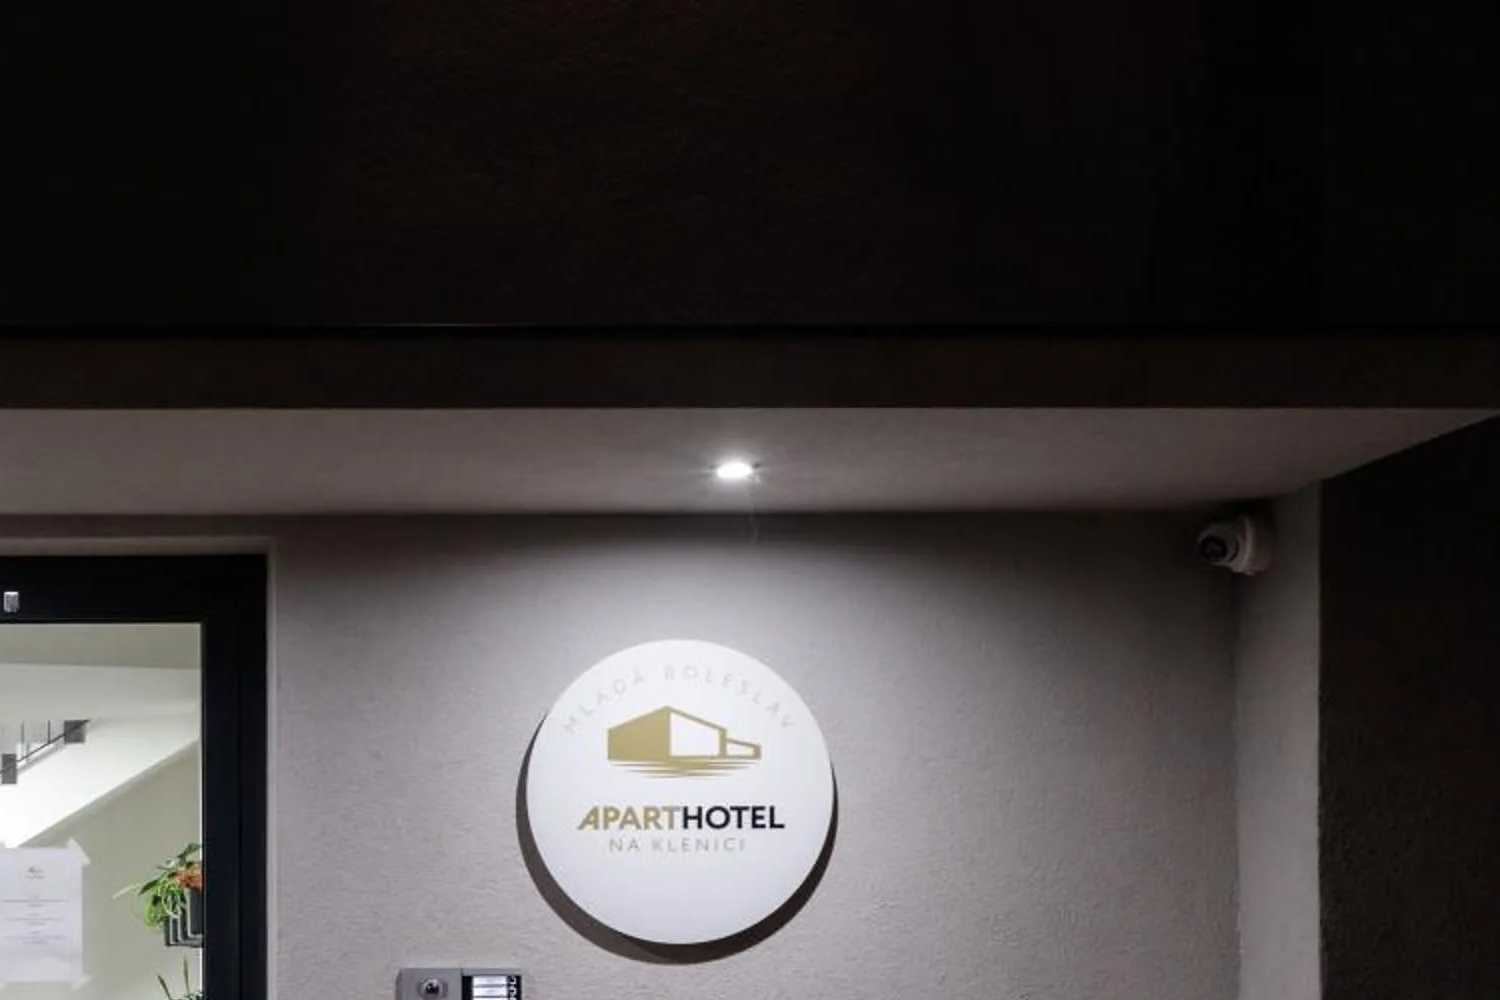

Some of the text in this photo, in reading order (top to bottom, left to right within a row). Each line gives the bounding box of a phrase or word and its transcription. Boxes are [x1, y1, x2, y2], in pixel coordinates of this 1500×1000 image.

[664, 664, 795, 730] BOLESLAV
[577, 805, 785, 830] APARTHOTEL
[609, 836, 745, 853] NA KLENICI
